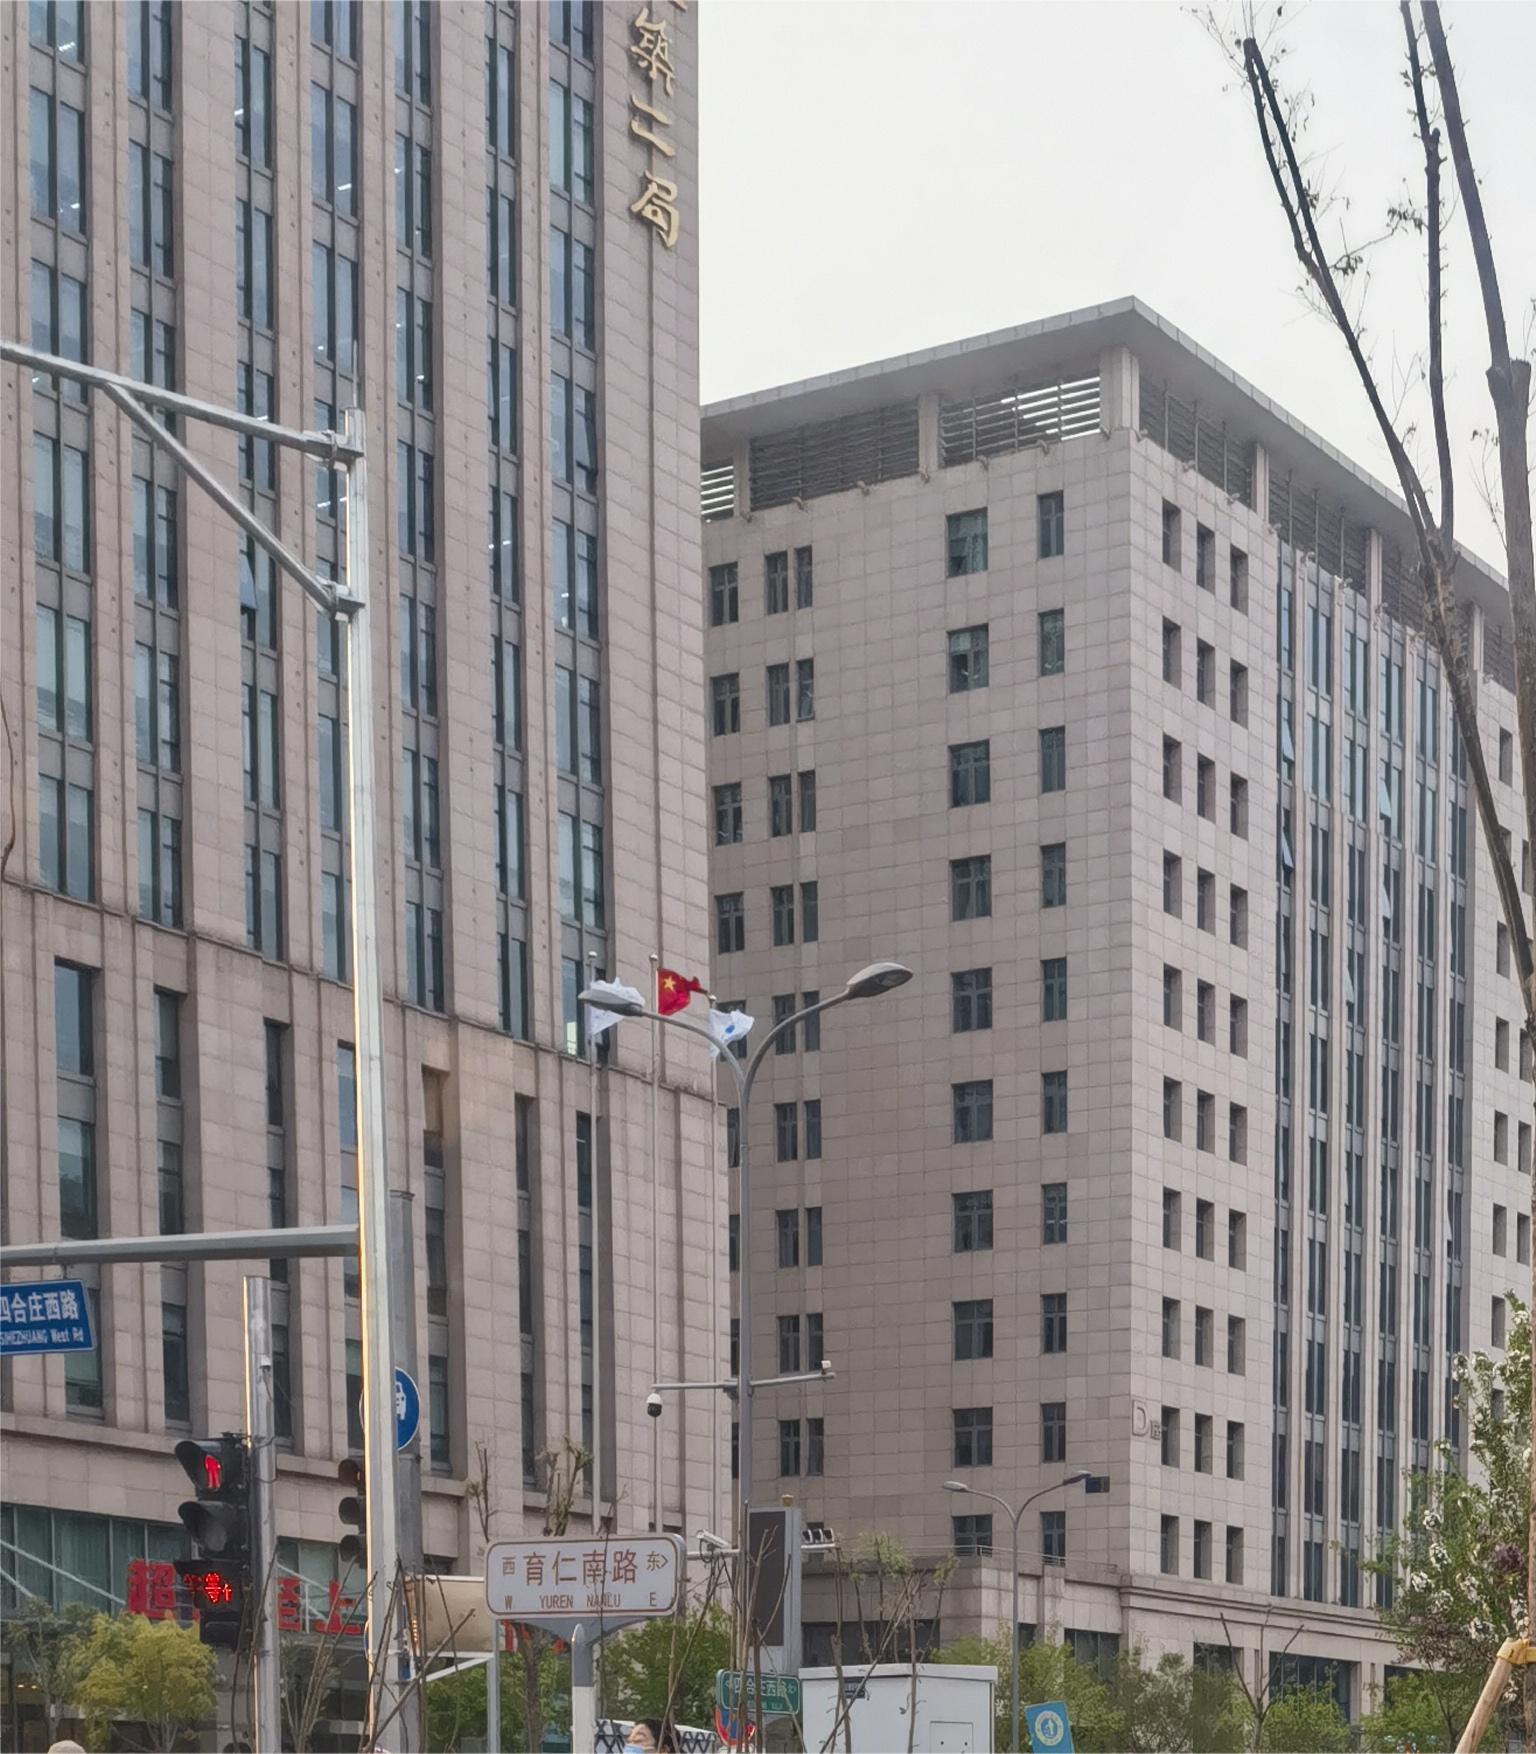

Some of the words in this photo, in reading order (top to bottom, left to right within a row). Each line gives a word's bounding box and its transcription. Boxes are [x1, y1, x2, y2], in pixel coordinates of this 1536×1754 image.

[631, 0, 687, 247] 築二局
[502, 1556, 516, 1576] 西
[523, 1549, 638, 1586] 育仁南路
[505, 1595, 513, 1610] W
[539, 1594, 574, 1609] YUREN
[649, 1592, 657, 1607] E
